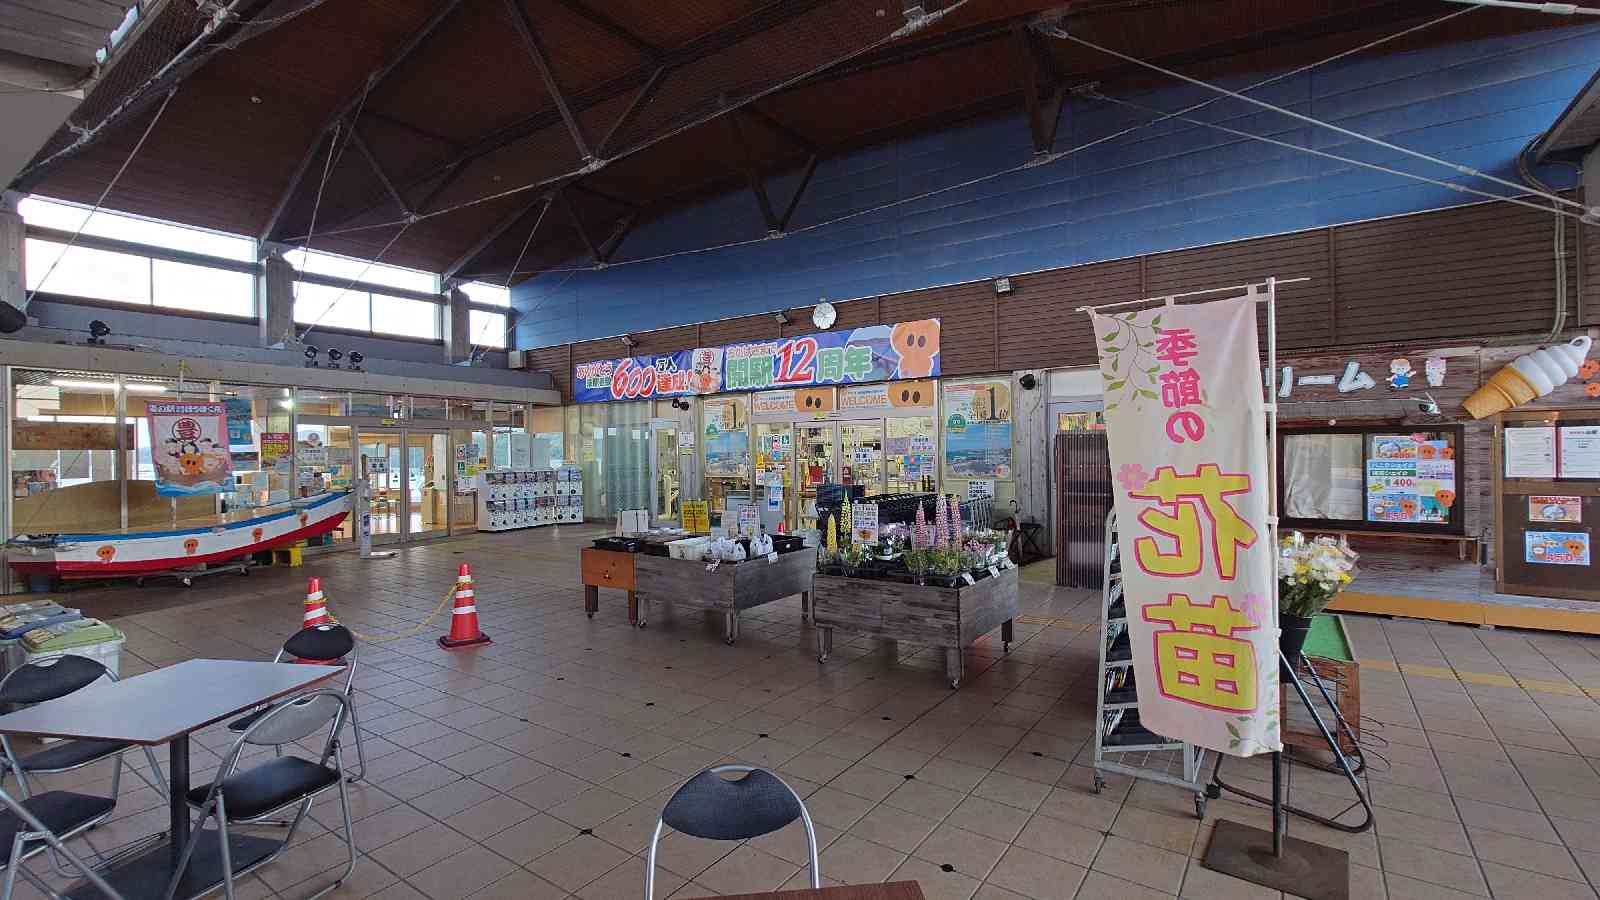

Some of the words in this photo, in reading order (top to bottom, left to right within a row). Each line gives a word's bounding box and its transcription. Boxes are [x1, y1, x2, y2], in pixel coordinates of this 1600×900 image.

[656, 357, 678, 372] 万人
[611, 358, 657, 399] 600
[753, 400, 795, 411] WELCOME
[840, 394, 888, 407] WELCOME
